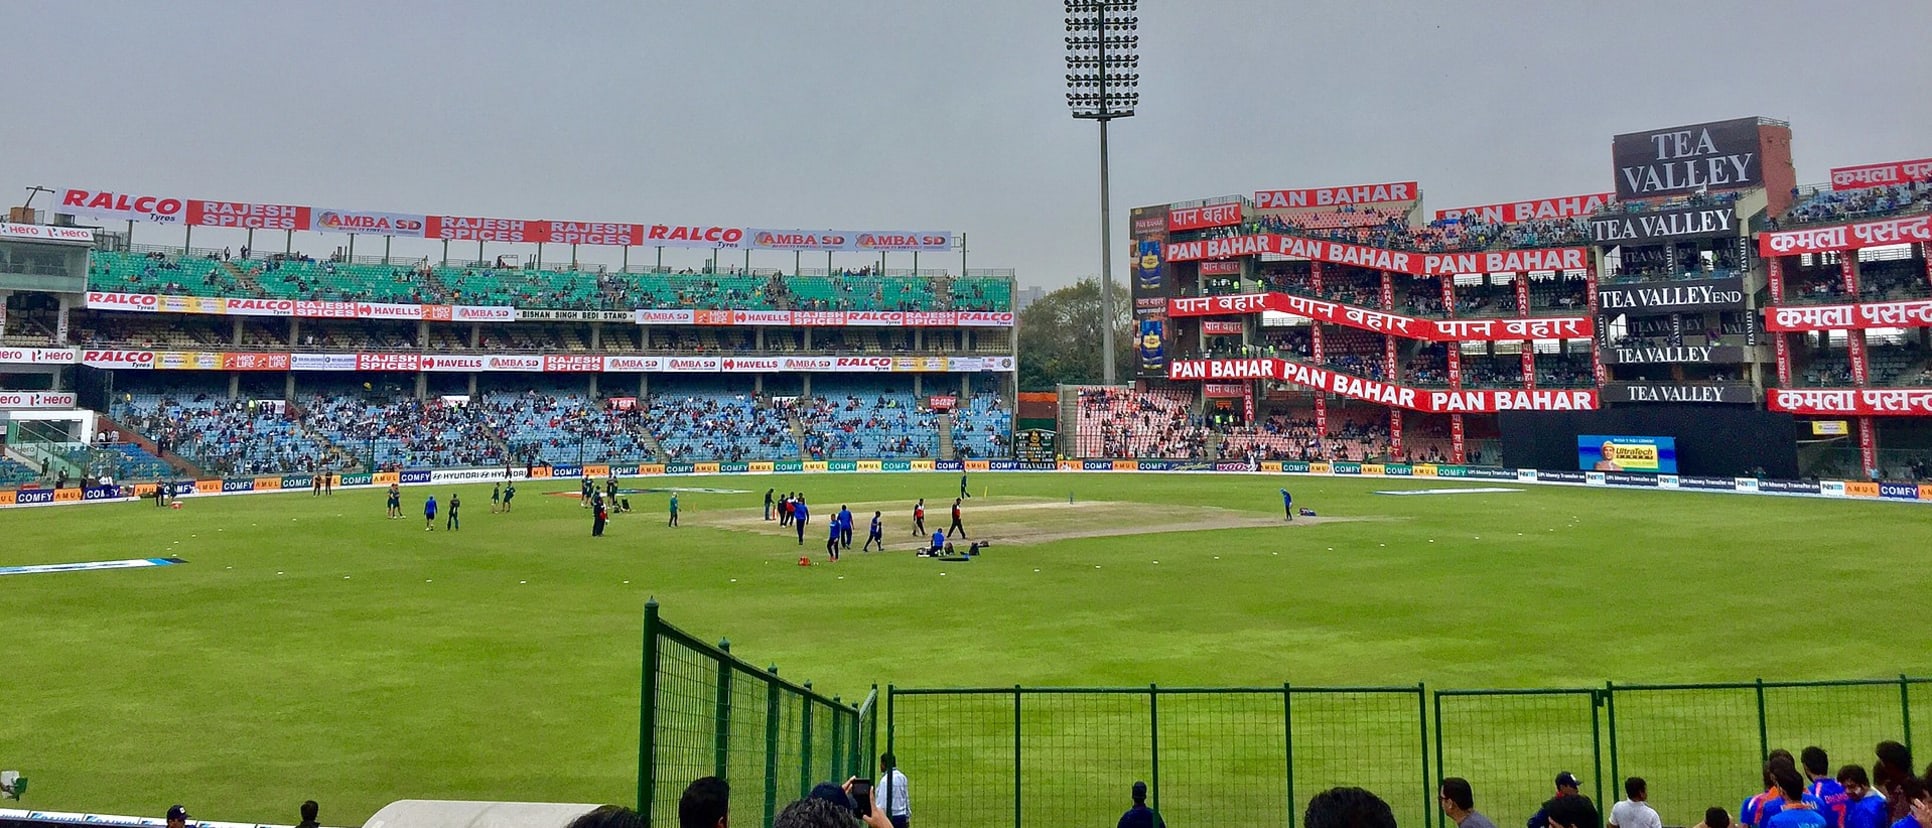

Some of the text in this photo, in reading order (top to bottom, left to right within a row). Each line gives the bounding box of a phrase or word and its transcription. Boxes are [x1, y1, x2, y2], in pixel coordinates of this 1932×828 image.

[1651, 127, 1719, 161] TEA
[1622, 153, 1753, 193] VALLEY
[1833, 165, 1898, 185] कमला
[1256, 184, 1409, 208] PAN BAHAR
[62, 189, 182, 215] RALCO
[203, 203, 297, 217] RAJESH
[1172, 204, 1239, 226] पान बहार
[150, 213, 176, 223] Tyres
[202, 215, 296, 229] SPICES
[327, 215, 390, 229] AMBA
[395, 219, 422, 230] SD
[440, 217, 525, 231] RAJESH
[551, 222, 632, 234] RAJESH
[1591, 208, 1733, 242] TEA VALLEY
[440, 229, 524, 242] SPICES
[550, 232, 632, 245] SPICES
[648, 225, 743, 242] RALCO
[1770, 215, 1931, 252] कमला पसन्द
[763, 233, 845, 246] AMBA SD
[865, 233, 946, 246] AMBA SD
[717, 241, 739, 249] Tyres
[1168, 235, 1269, 260] PAN BAHAR
[1280, 237, 1409, 272] PAN BAHAR
[1424, 249, 1582, 273] PAN BAHAR
[89, 293, 156, 305] RALCO
[1600, 285, 1742, 309] TEA VALLEY END
[228, 300, 292, 310] RALCO
[295, 301, 355, 309] RAJESH
[1174, 293, 1270, 312] पान बहार
[296, 309, 356, 317] SPICES
[374, 307, 421, 315] HAVELLS
[522, 310, 627, 319] BISHAN SINGH BEDI STAND
[643, 312, 674, 320] AMBA
[1288, 294, 1416, 334] पान बहार
[1776, 305, 1854, 327] कमला
[748, 313, 789, 321] HAVELLS
[794, 317, 844, 325] SPICES
[848, 313, 900, 321] RALCO
[906, 317, 956, 325] SPICES
[959, 313, 1012, 321] RALCO
[1433, 317, 1585, 338] पान बहार
[0, 351, 22, 360] ero
[84, 351, 153, 362] RALCO
[360, 354, 418, 362] RAJESH
[1616, 346, 1711, 363] TEA VALLEY
[437, 360, 482, 368] HAVELLS
[526, 359, 539, 367] SD
[547, 356, 601, 364] RAJESH
[837, 358, 890, 366] RALCO
[360, 362, 418, 370] SPICES
[547, 363, 601, 371] SPICES
[1171, 359, 1274, 378] PAN BAHAR
[1283, 362, 1416, 408] PAN BAHAR
[1627, 385, 1725, 402] TEA VALLEY
[0, 395, 21, 404] ero
[1431, 391, 1592, 411] PAN BAHAR
[1777, 389, 1857, 411] कमला
[1616, 447, 1653, 456] UltraTech
[585, 466, 608, 475] AMUL
[667, 465, 695, 474] COMFY
[721, 464, 748, 472] COMFY
[751, 463, 773, 471] AMUL
[775, 463, 802, 471] COMFY
[883, 462, 910, 470] COMFY
[1335, 464, 1361, 472] COMFY
[401, 472, 431, 481] COMFY
[443, 472, 479, 480] HYUNDAI
[553, 468, 582, 476] COMFY
[1438, 468, 1466, 476] COMFY
[256, 479, 279, 487] AMUL
[282, 478, 312, 488] COMFY
[342, 475, 372, 485] COMFY
[374, 474, 398, 482] AMUL
[223, 481, 254, 490] COMFY
[1846, 485, 1876, 494] AMUL
[56, 491, 81, 500] AMUL
[1880, 486, 1917, 497] COMFY
[18, 492, 53, 502] COMFY
